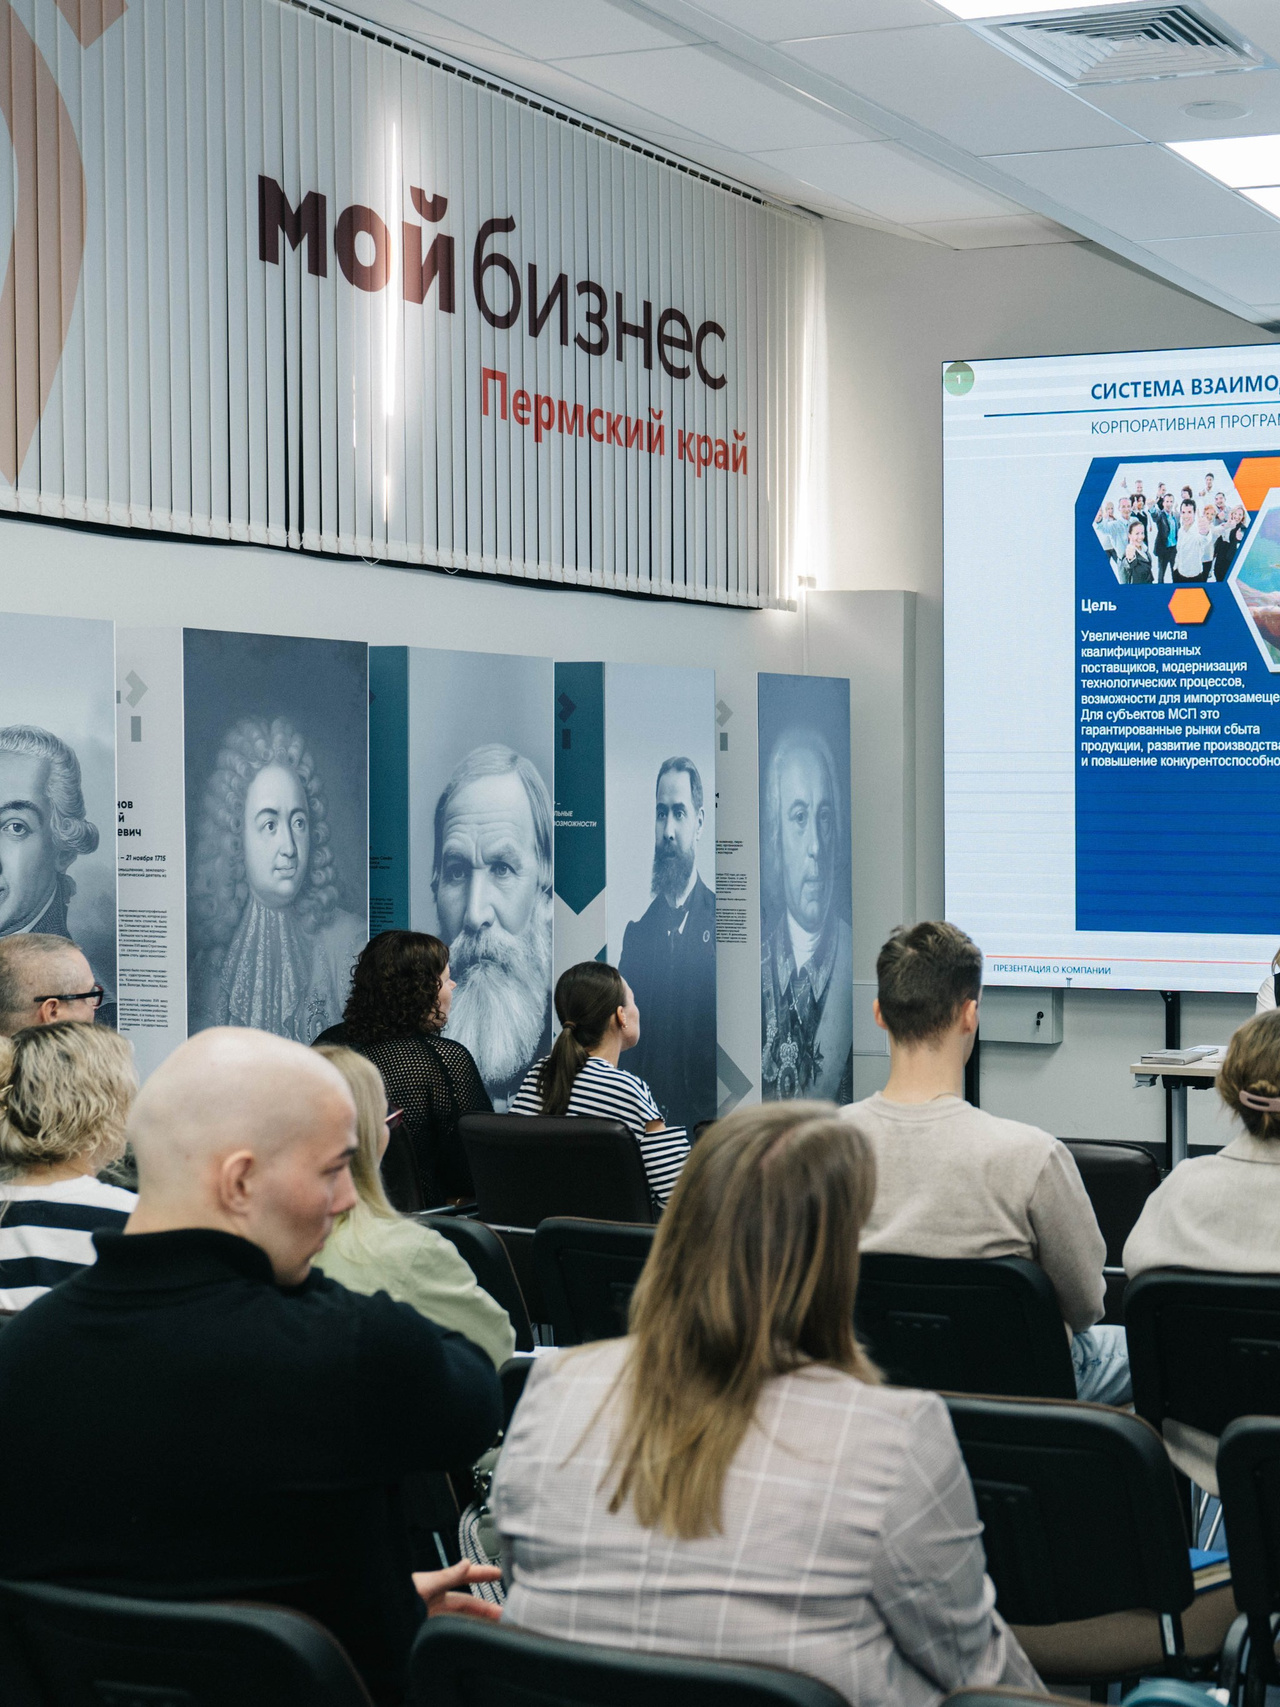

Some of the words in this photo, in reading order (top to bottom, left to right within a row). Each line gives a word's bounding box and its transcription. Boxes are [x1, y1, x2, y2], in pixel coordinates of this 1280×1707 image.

[258, 174, 455, 314] мой
[473, 214, 728, 390] бизнес
[1091, 380, 1184, 400] СИСТЕМА
[482, 367, 666, 456] Пермский
[678, 429, 748, 478] край
[1092, 416, 1215, 434] КОРПОРАТИВНАЯ
[1082, 599, 1116, 613] Цель
[1081, 630, 1150, 641] Увеличение
[1153, 631, 1187, 640] числа
[1082, 646, 1201, 659] квалифицированных
[1081, 664, 1158, 675] поставщиков,
[1162, 662, 1247, 674] модернизация
[1081, 679, 1177, 688] технологических
[1180, 678, 1244, 690] процессов,
[1082, 695, 1156, 704] возможности
[1159, 695, 1180, 705] для
[1081, 709, 1103, 722] Для
[1106, 709, 1165, 722] субъектов
[1169, 708, 1196, 719] МСП
[1200, 710, 1219, 719] это
[1082, 726, 1182, 738] гарантированные
[1185, 726, 1221, 737] рынки
[1224, 723, 1260, 734] сбыта
[1081, 742, 1143, 754] продукции,
[1148, 742, 1200, 753] развитие
[1082, 758, 1088, 766] и
[1092, 757, 1157, 766] повышение
[994, 964, 1050, 974] ПРЕЗЕНТАЦИЯ
[1062, 966, 1111, 974] КОМПАНИИ
